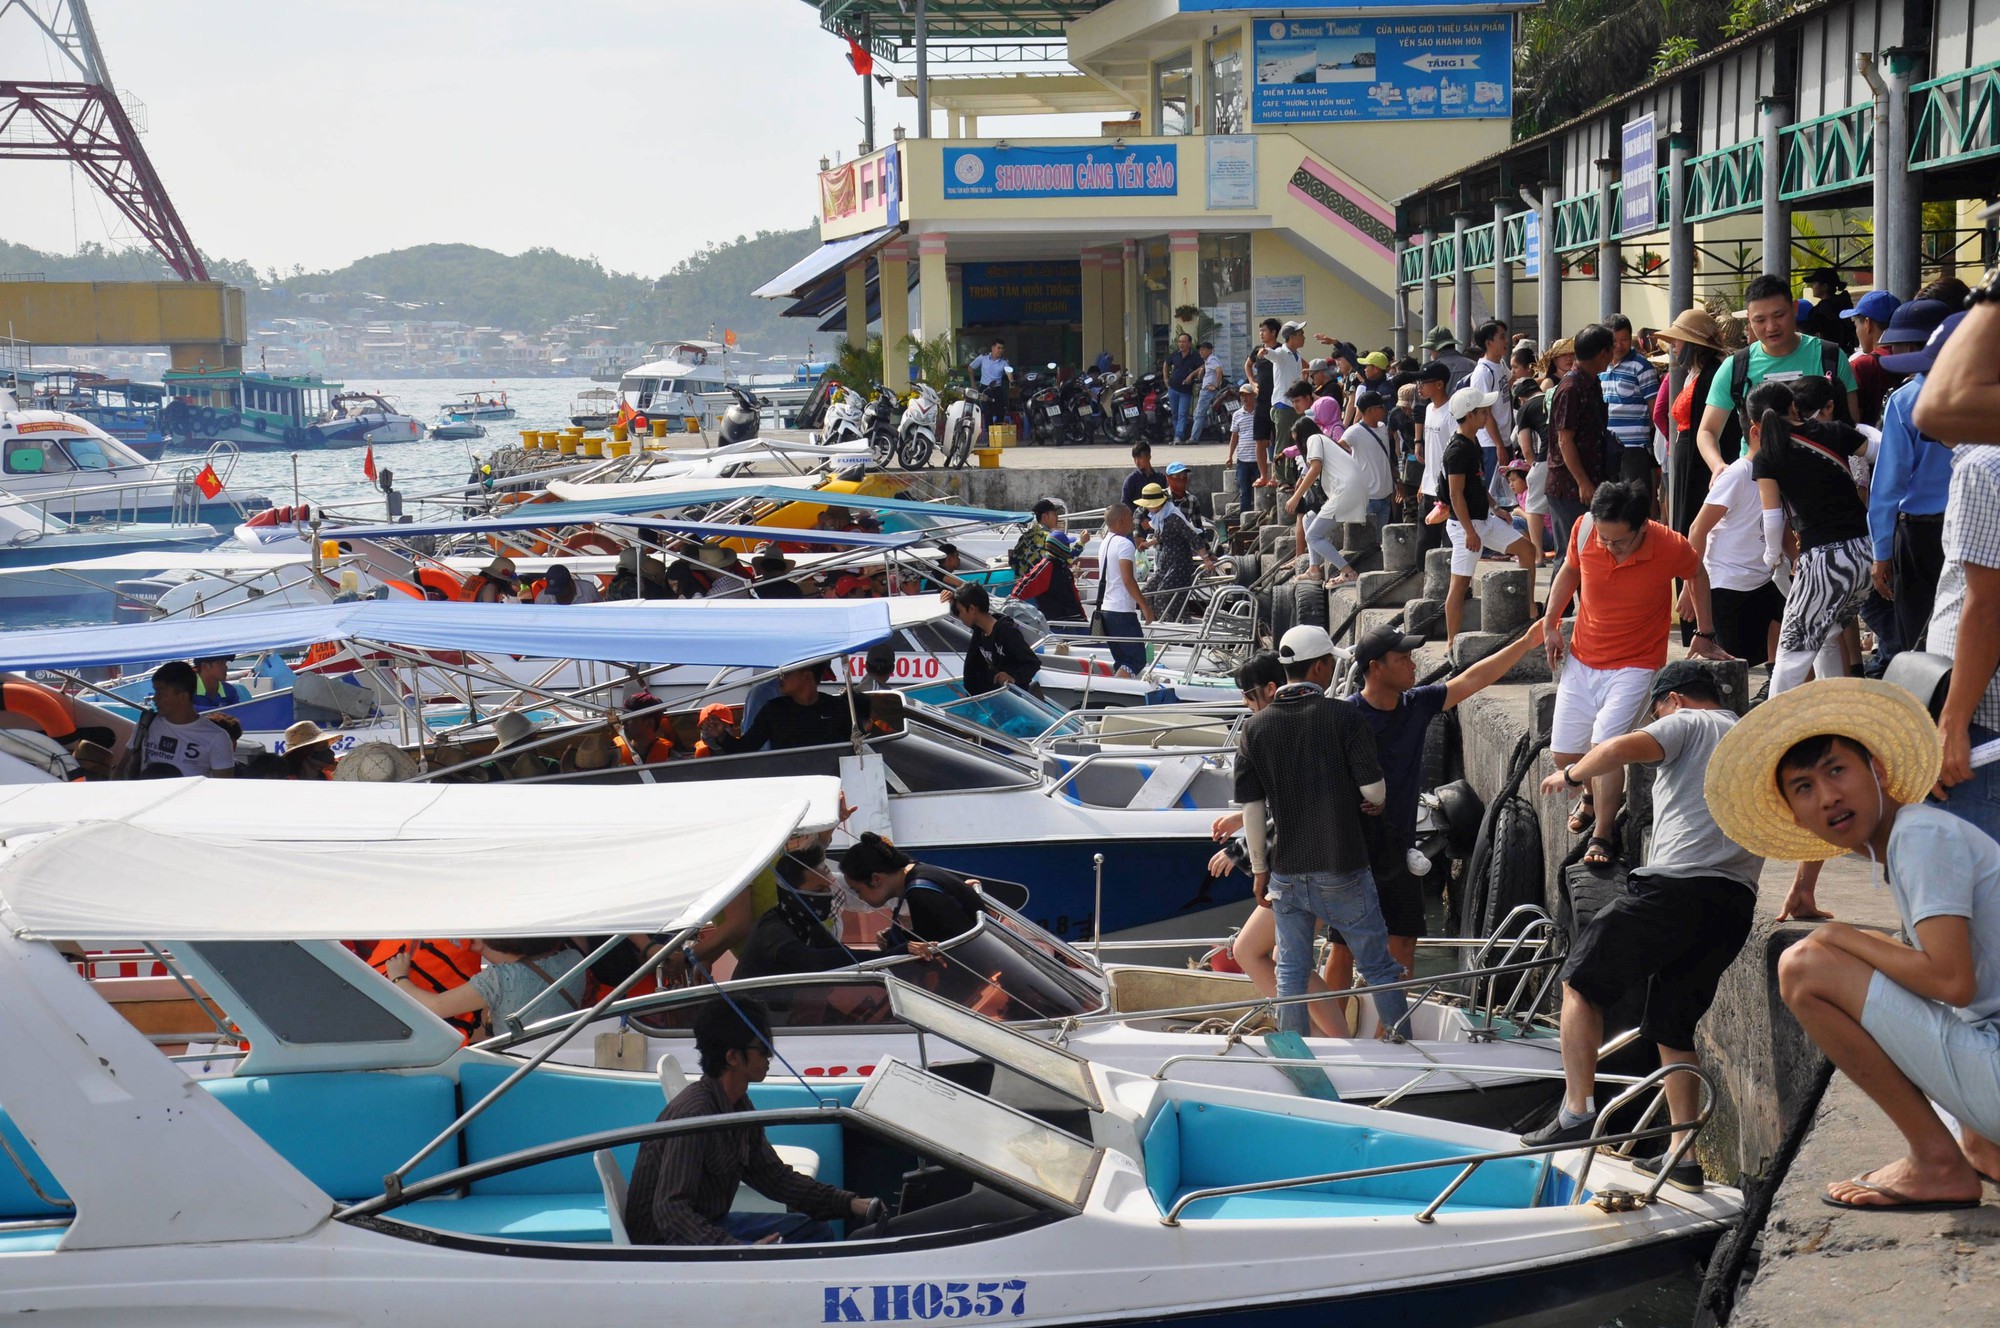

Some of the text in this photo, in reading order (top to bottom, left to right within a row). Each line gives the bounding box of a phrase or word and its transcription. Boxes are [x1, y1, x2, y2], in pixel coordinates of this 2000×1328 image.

[1262, 99, 1279, 107] CAFE
[995, 163, 1074, 192] SHOWROOM
[1076, 154, 1113, 190] CẢNG
[1115, 153, 1144, 189] YẾN
[1146, 156, 1174, 188] SÀO
[184, 742, 200, 759] 5
[820, 1279, 1029, 1323] KH0557
